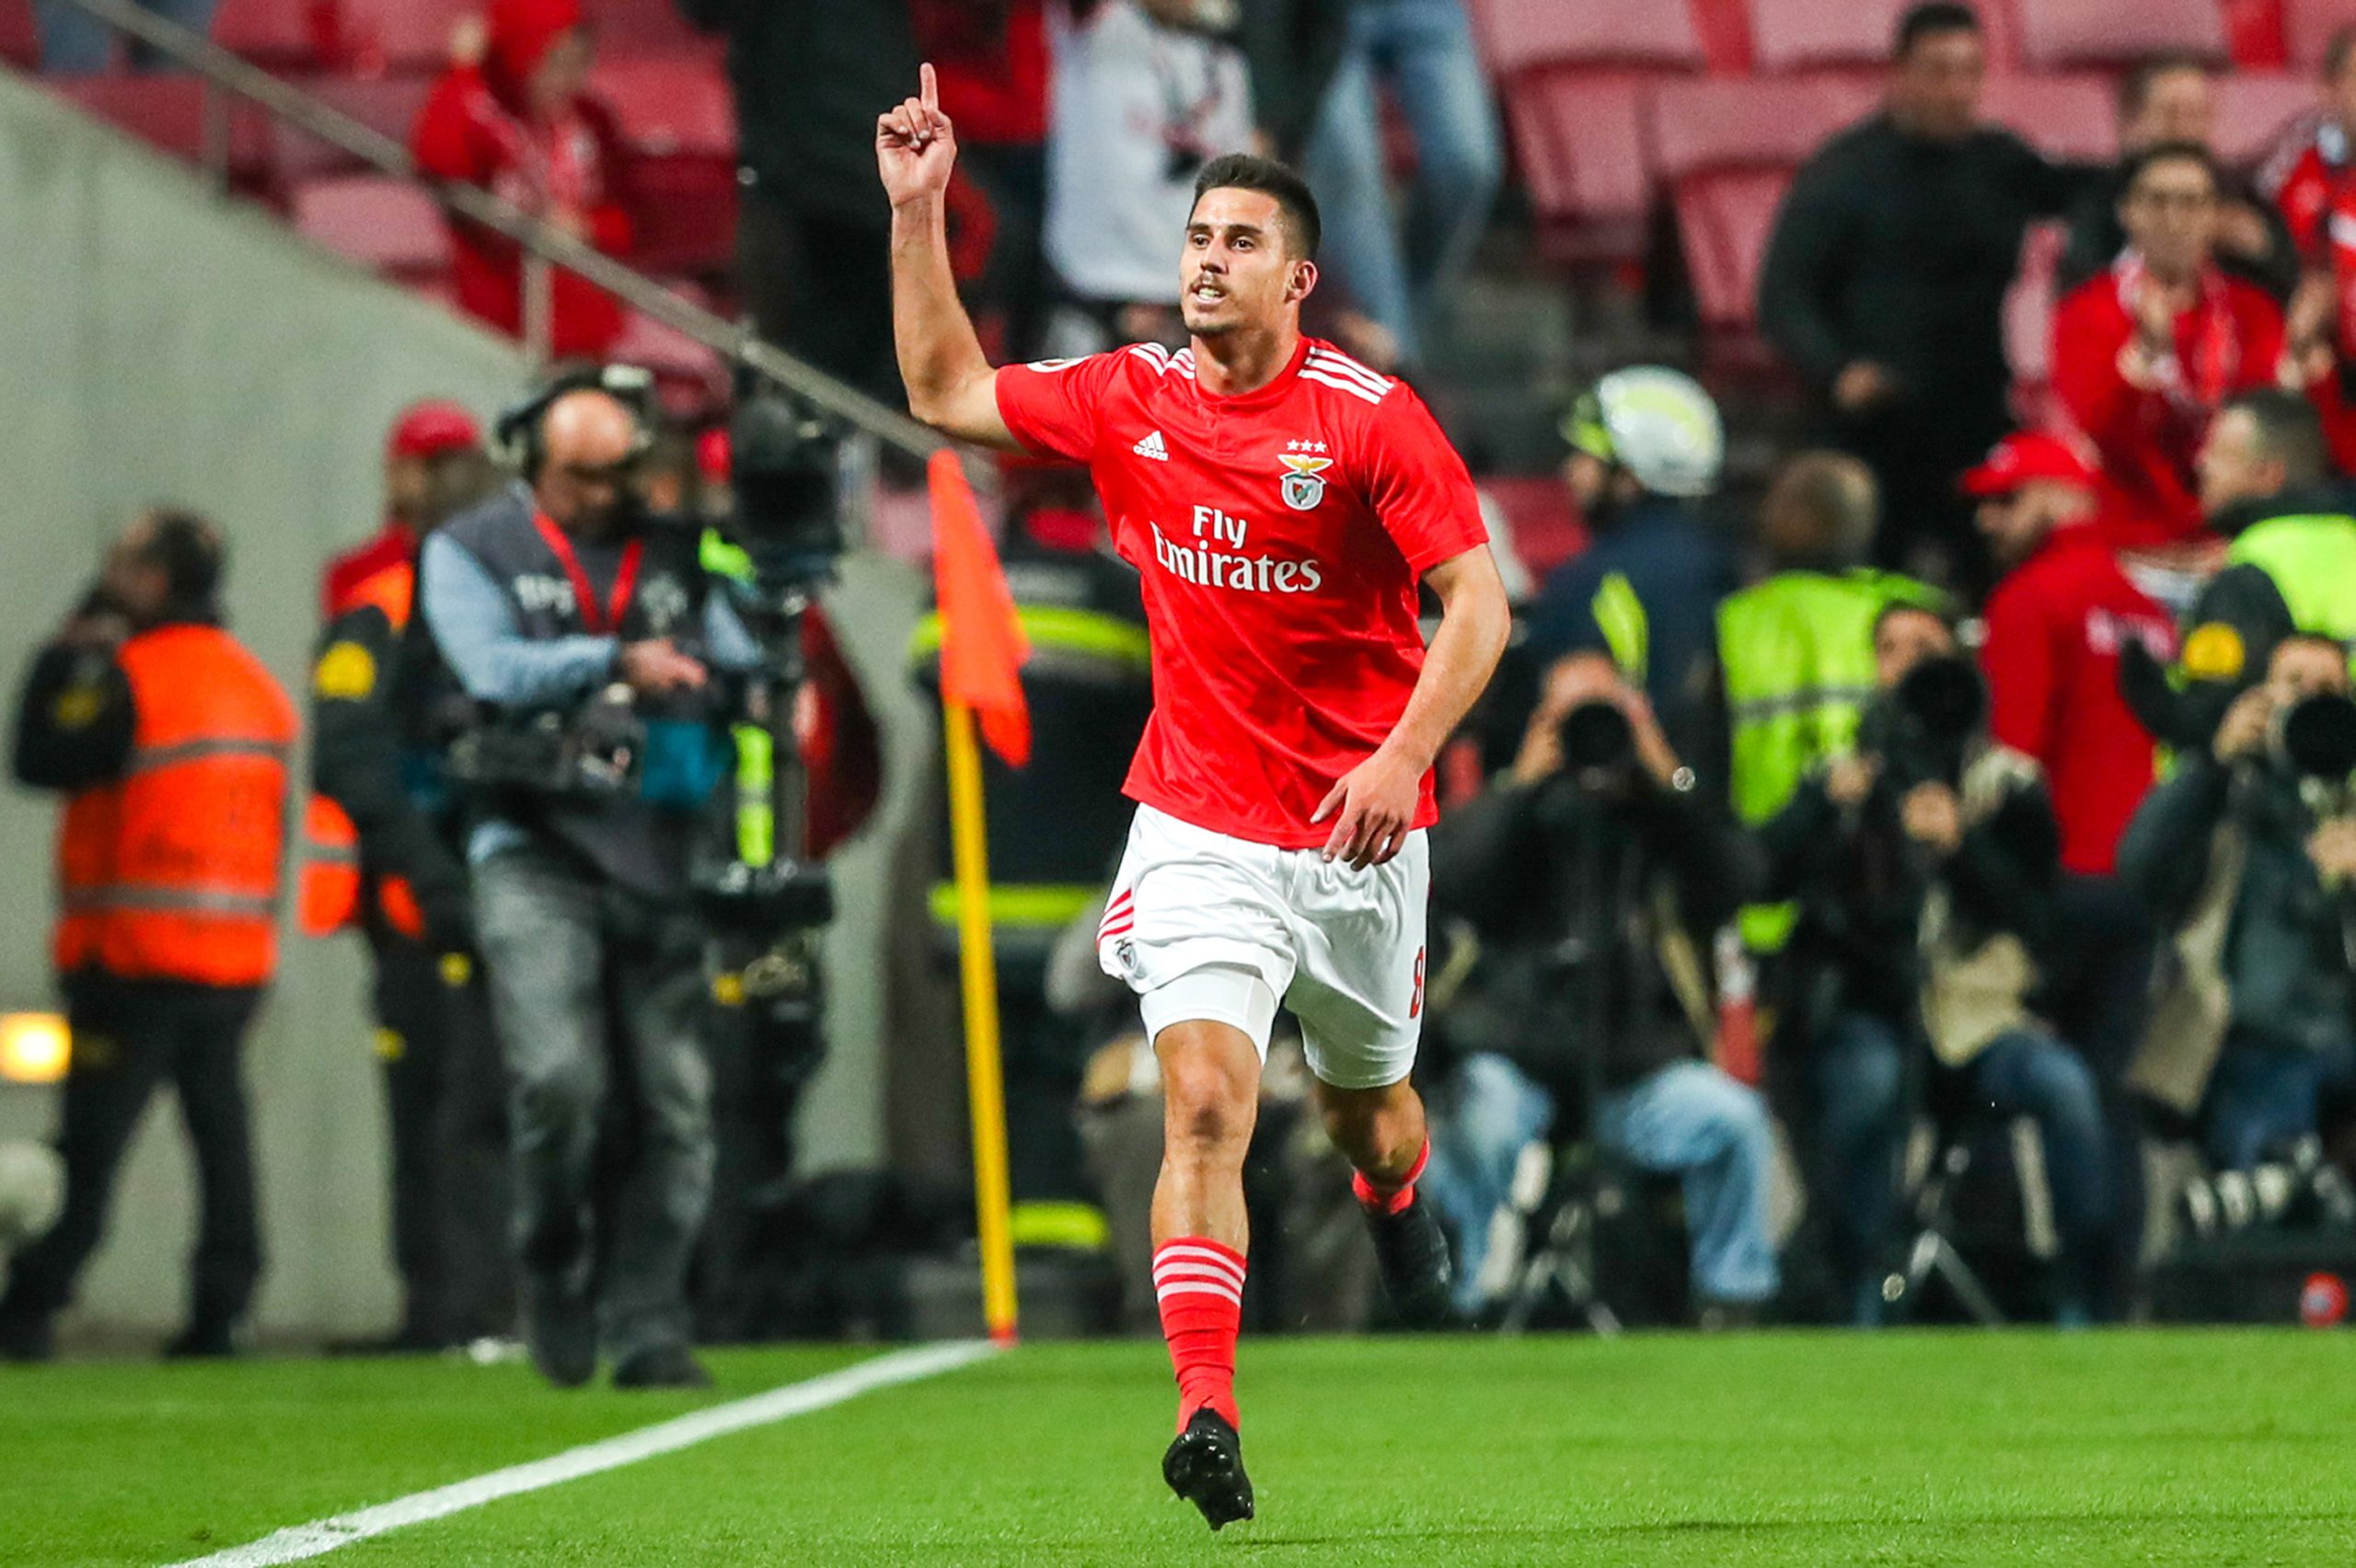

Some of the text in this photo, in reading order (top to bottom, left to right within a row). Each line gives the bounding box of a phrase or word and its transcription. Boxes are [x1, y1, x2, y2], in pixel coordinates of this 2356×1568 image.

[1150, 521, 1322, 592] Emirates
[1193, 505, 1247, 548] Fly
[1409, 945, 1425, 1020] 8
